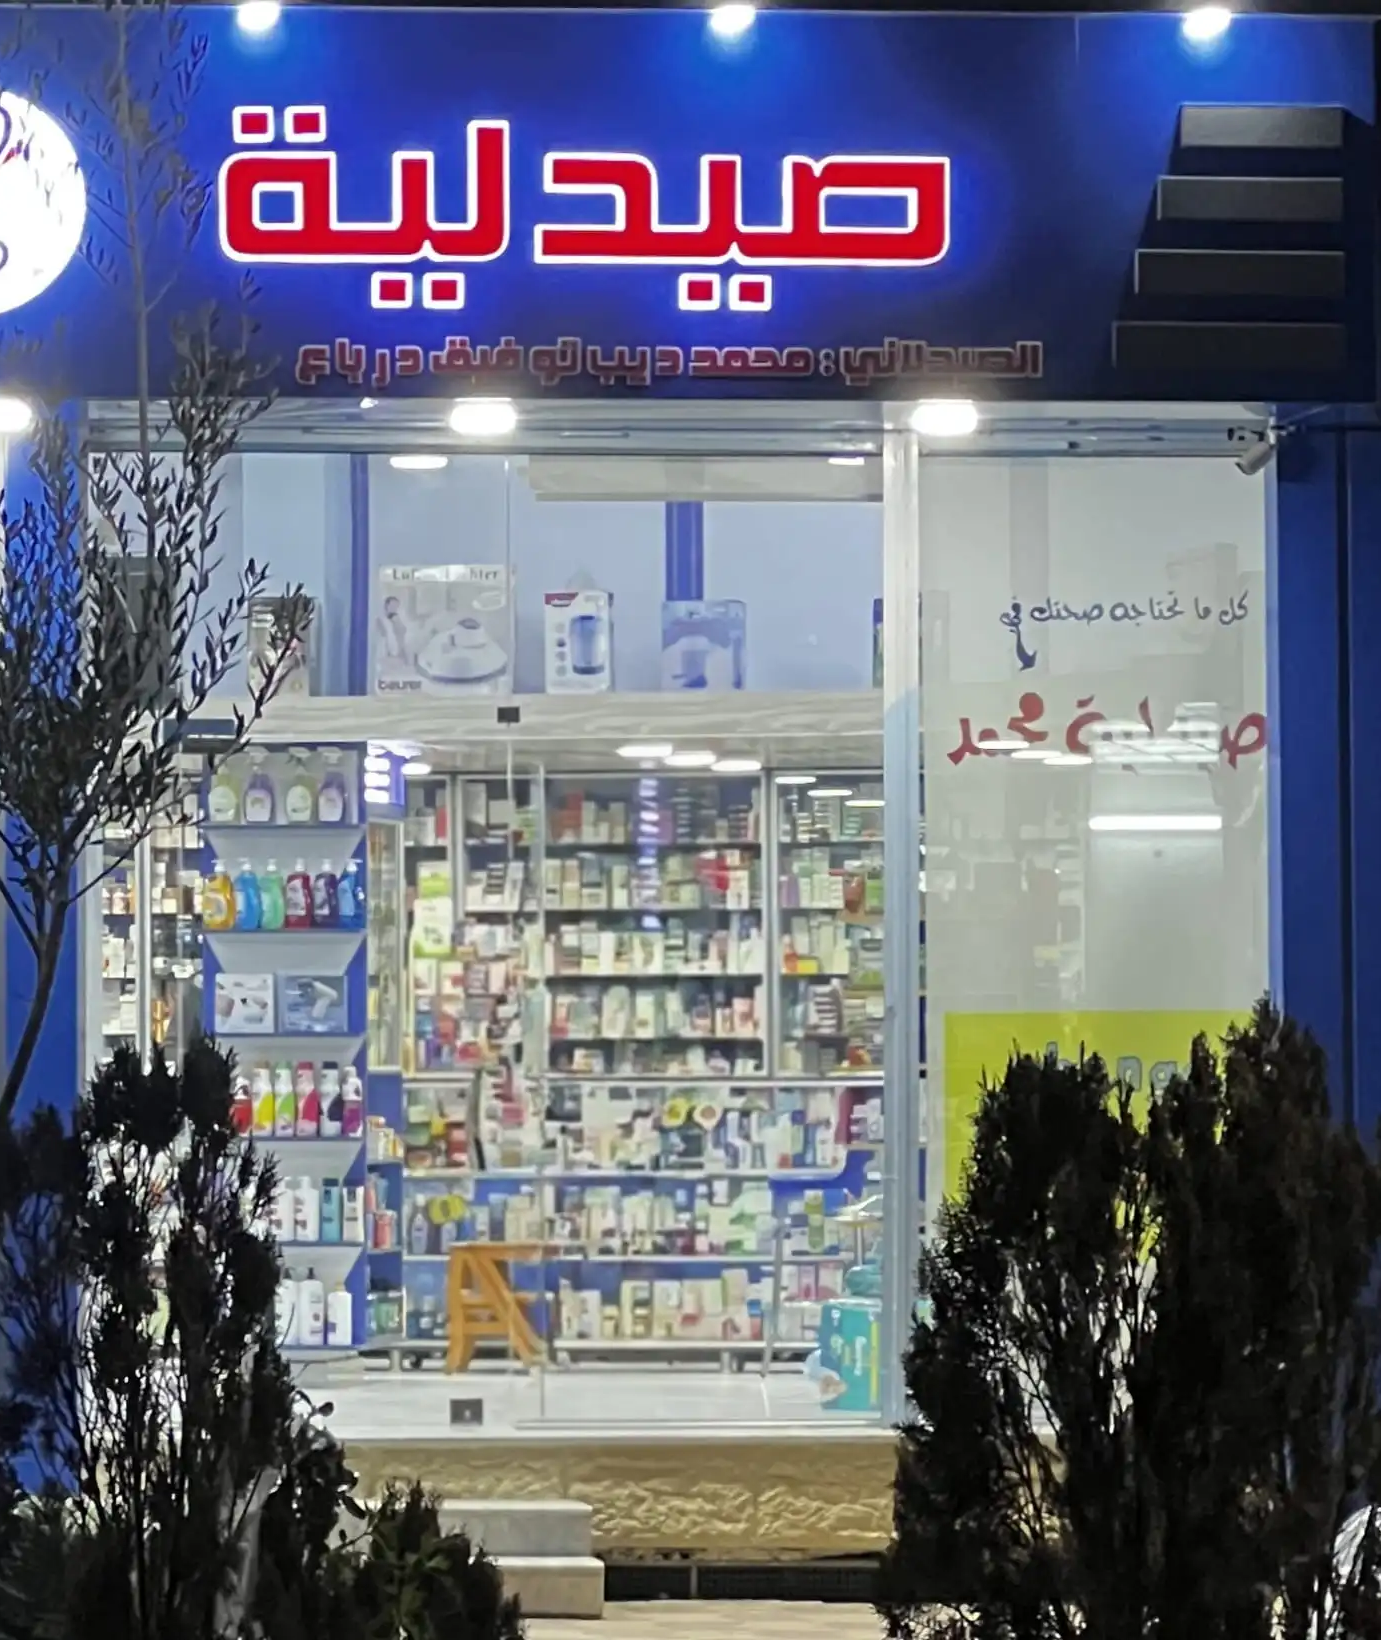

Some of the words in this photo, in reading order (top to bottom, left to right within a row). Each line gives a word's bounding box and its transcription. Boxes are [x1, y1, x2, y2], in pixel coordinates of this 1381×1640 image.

[219, 105, 952, 311] صيدلية
[689, 345, 814, 378] محمد
[1194, 596, 1212, 621] ما
[1219, 589, 1249, 626] كل
